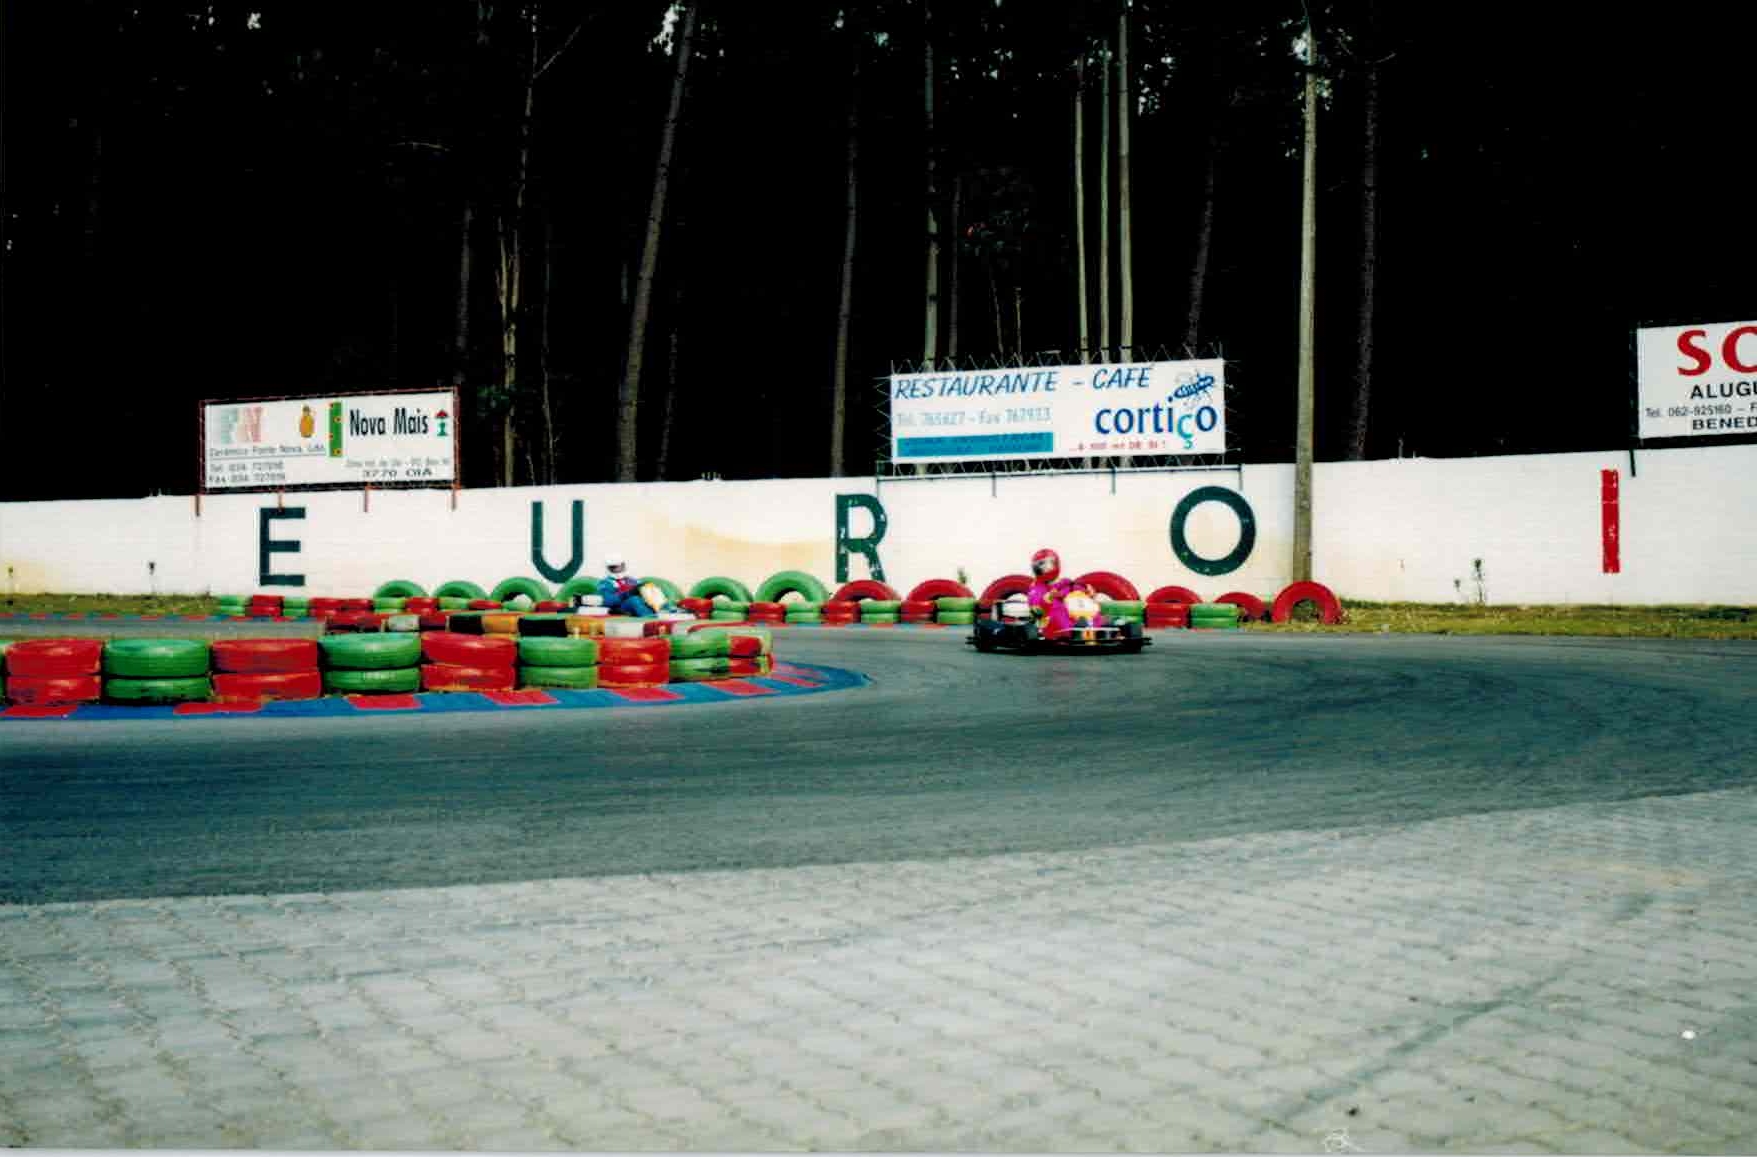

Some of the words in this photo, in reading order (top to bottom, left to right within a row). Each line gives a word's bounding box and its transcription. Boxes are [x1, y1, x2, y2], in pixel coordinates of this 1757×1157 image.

[894, 371, 1060, 399] RESTAURANTE
[349, 409, 386, 436] Nova
[393, 406, 429, 435] Mais
